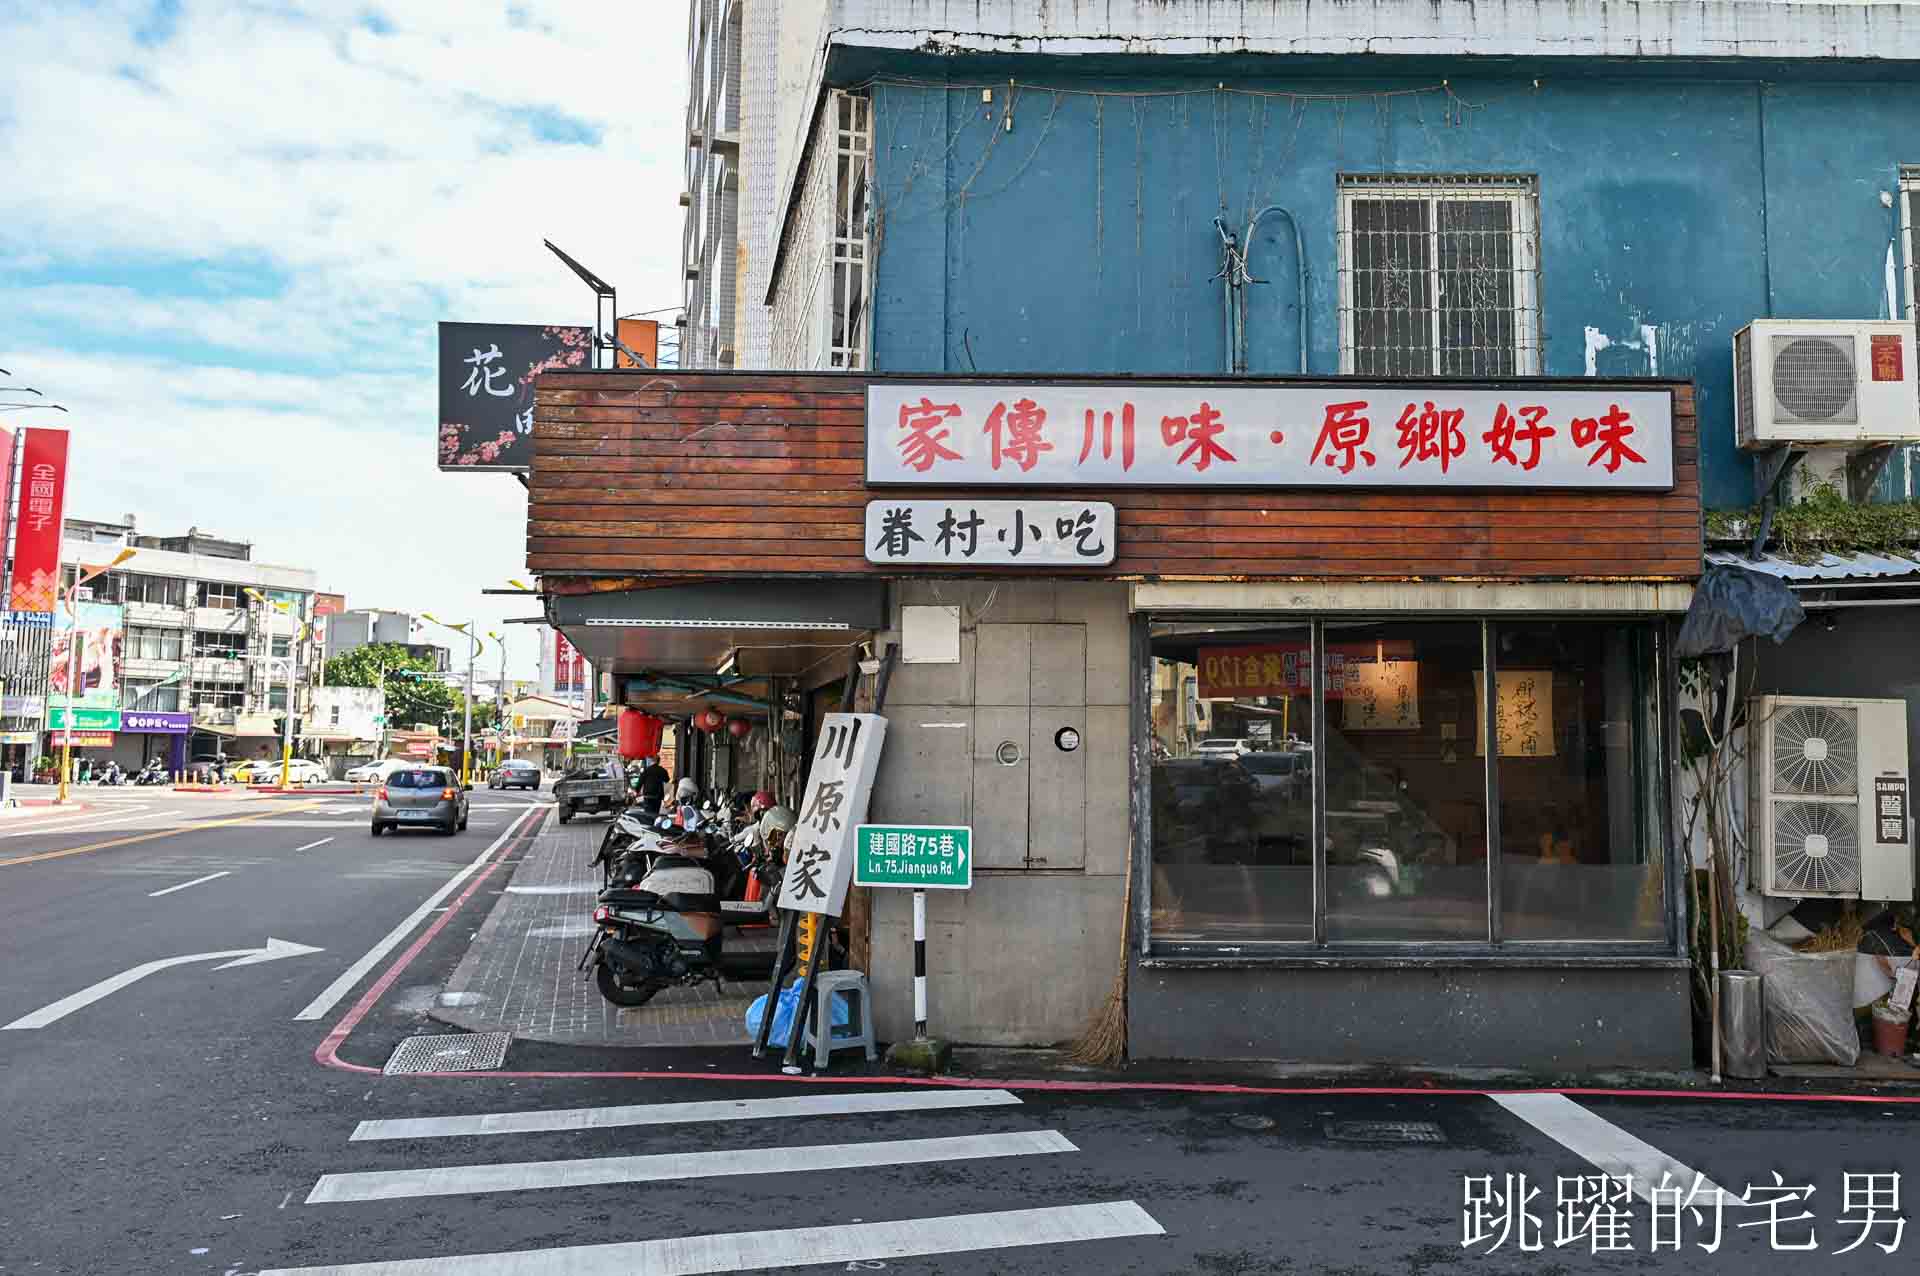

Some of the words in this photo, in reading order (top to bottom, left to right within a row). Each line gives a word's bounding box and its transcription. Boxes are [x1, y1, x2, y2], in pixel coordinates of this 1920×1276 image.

[26, 463, 57, 532] 全國電子
[875, 507, 1105, 557] 眷村小吃
[789, 717, 862, 900] 川原家
[1876, 783, 1905, 792] SAMPO
[1880, 795, 1903, 840] 聲寶
[869, 832, 954, 857] 建國路75巷
